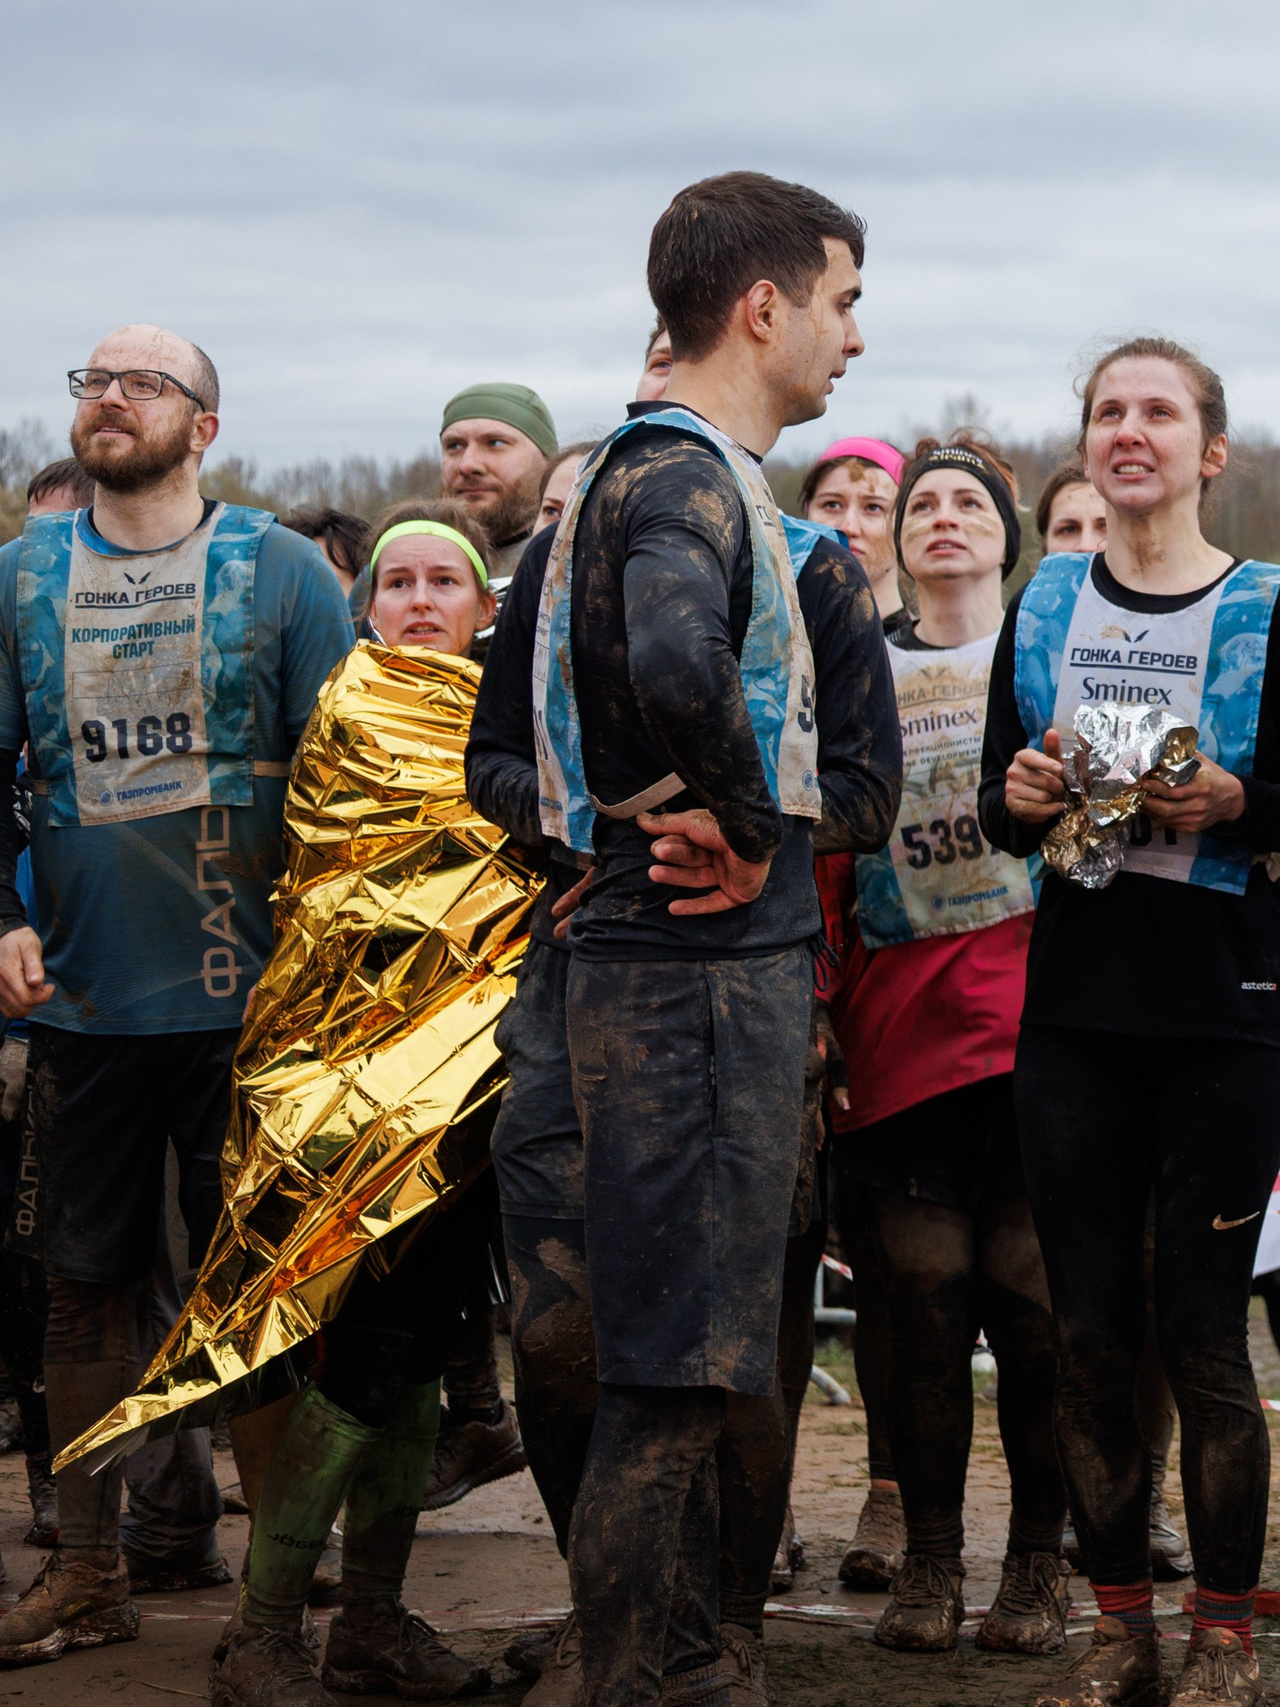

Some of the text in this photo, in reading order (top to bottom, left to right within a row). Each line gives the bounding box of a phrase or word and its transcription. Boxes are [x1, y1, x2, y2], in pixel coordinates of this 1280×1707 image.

[75, 583, 196, 605] ГОНКА ГЕРОЕВ
[72, 615, 196, 643] КОРПОРАТИВНЫЙ
[112, 641, 155, 659] СТАРТ
[1071, 648, 1198, 670] ГОНКА ГЕРОЕВ
[1081, 676, 1172, 706] Sminex
[81, 712, 193, 763] 9168
[116, 780, 182, 800] ГАЗПРОМБАНК
[901, 814, 1000, 870] 539
[949, 885, 1009, 906] ГАЗПРОМБАНК
